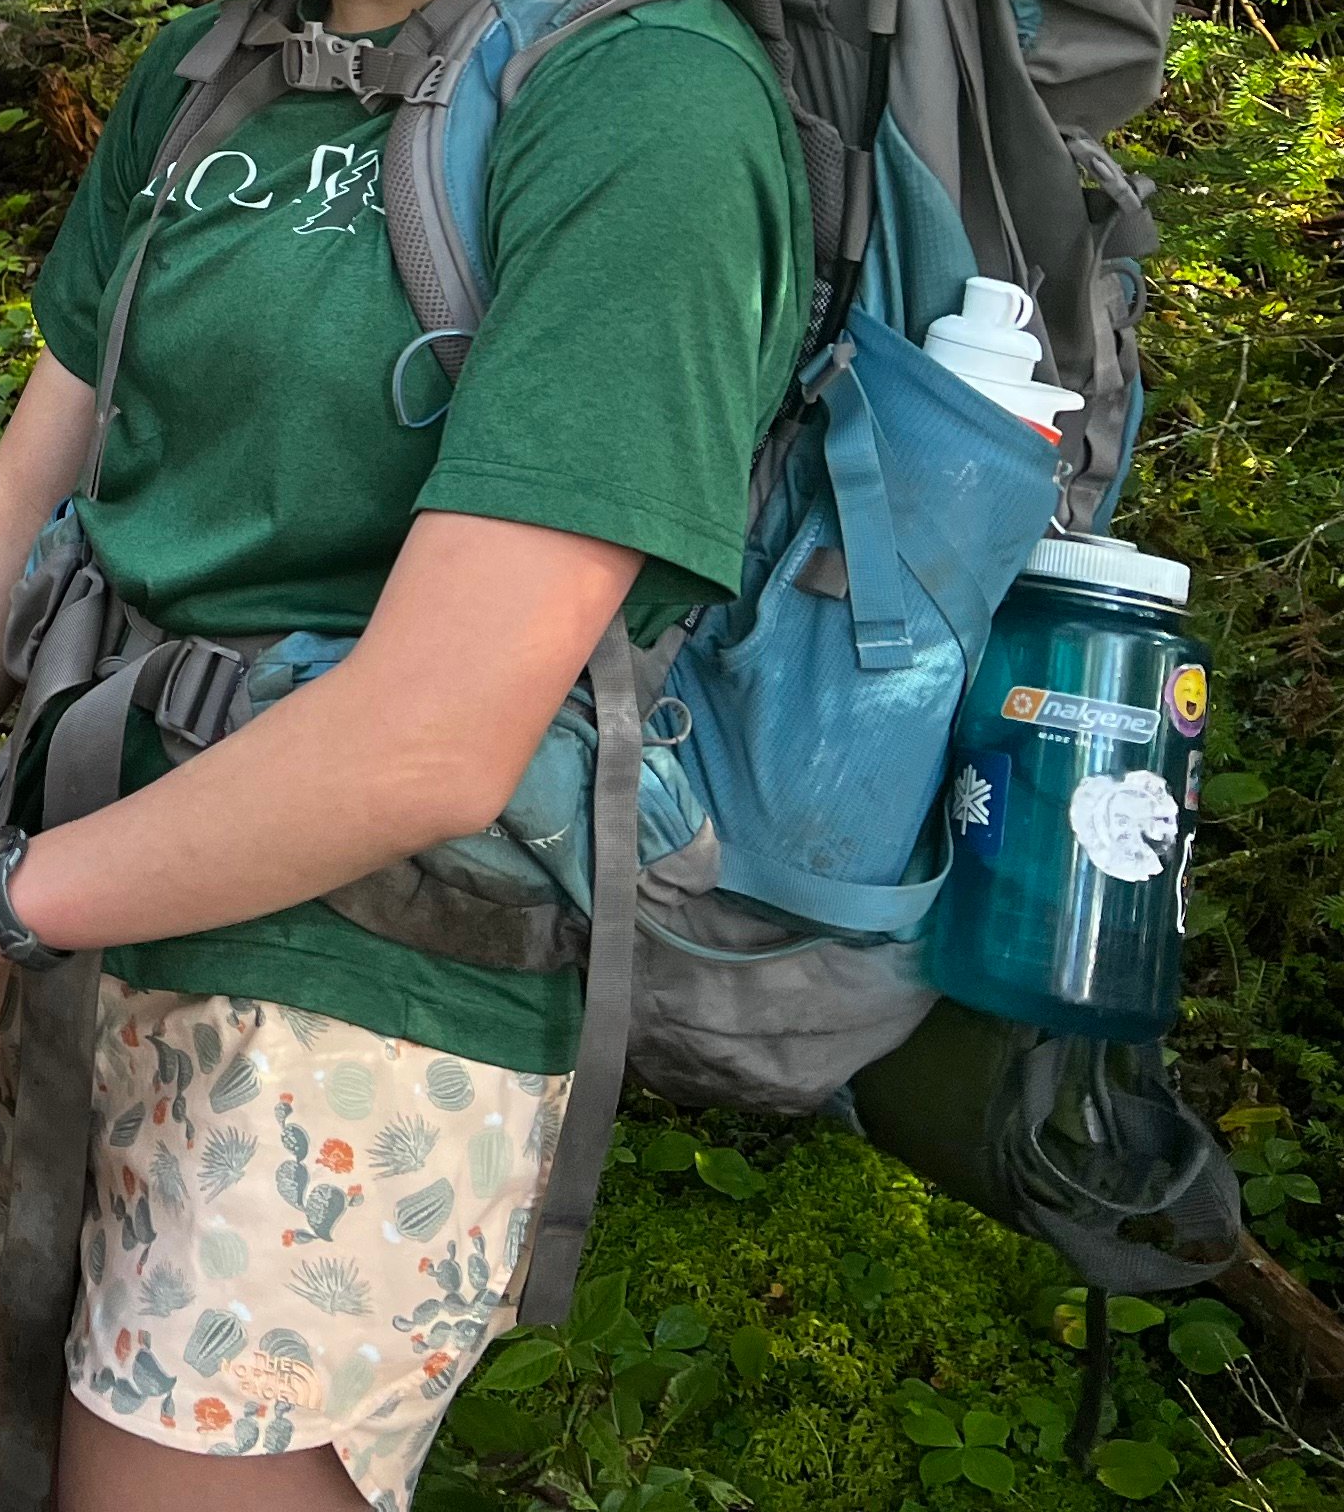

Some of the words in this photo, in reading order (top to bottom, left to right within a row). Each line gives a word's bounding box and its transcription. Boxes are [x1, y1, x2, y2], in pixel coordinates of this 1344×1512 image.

[1043, 700, 1154, 735] nalgene
[220, 1357, 292, 1388] NORTH
[253, 1351, 294, 1375] THE
[240, 1380, 290, 1403] FACE
